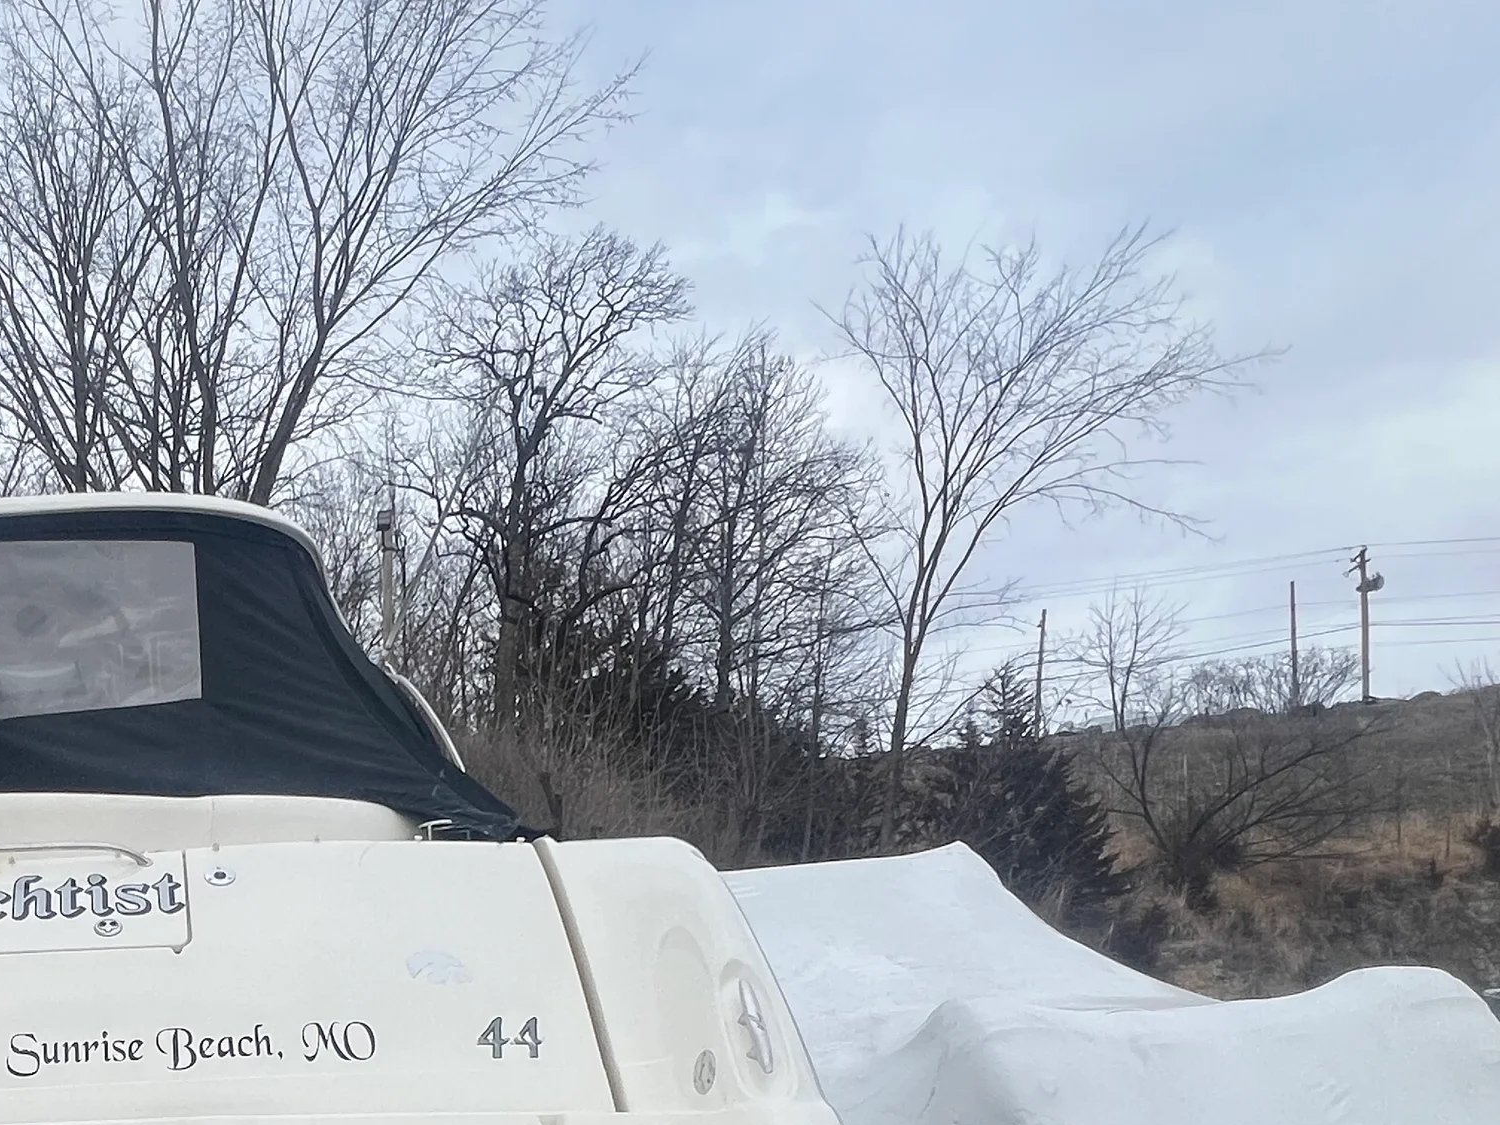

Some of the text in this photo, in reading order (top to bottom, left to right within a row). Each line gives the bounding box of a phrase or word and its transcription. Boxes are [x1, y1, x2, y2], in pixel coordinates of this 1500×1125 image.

[6, 1021, 376, 1077] Sunrise Beach, MO
[477, 1016, 543, 1059] 44
